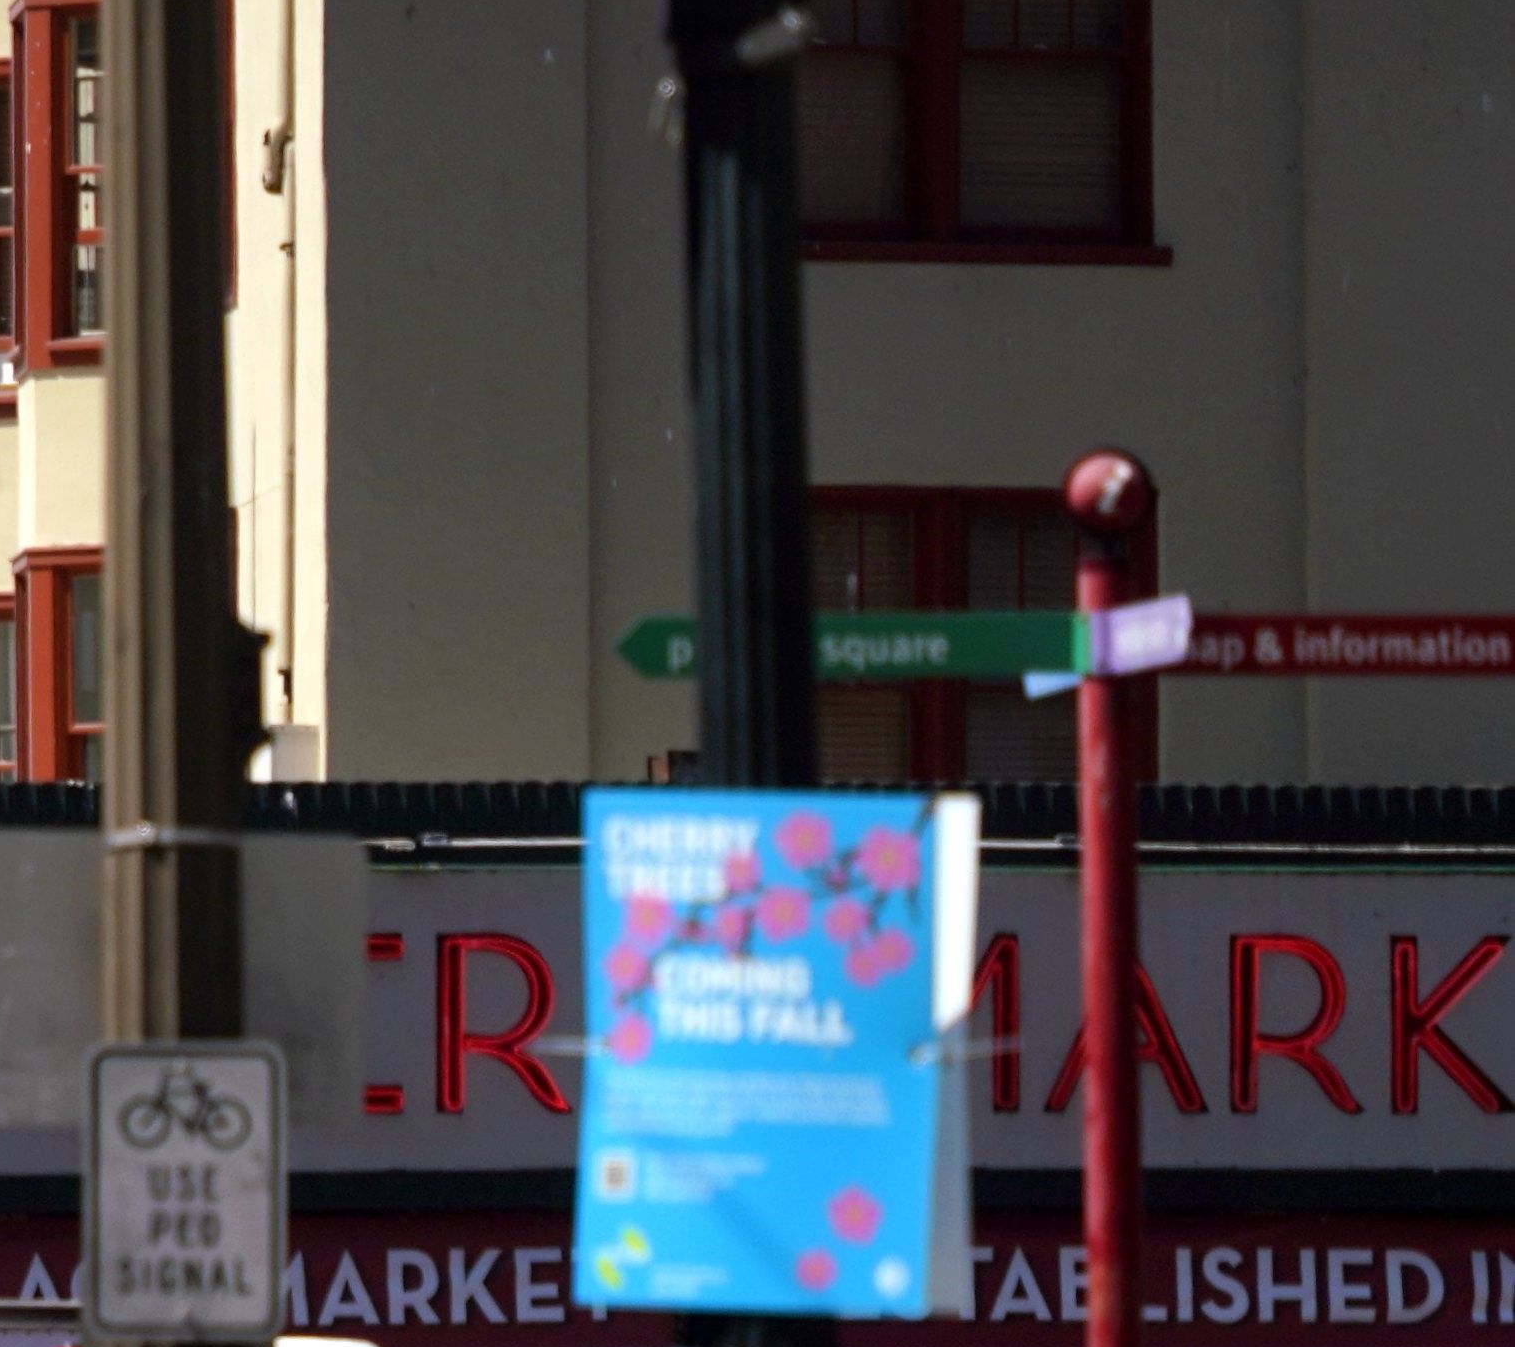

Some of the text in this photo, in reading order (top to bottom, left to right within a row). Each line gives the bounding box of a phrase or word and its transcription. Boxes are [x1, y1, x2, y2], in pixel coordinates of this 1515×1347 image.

[818, 630, 951, 671] square
[1253, 627, 1282, 663] &
[1293, 625, 1511, 664] information
[601, 813, 761, 859] CHERRY
[655, 956, 812, 997] COMING
[656, 997, 741, 1042] THIS
[146, 1164, 218, 1202] USE
[147, 1209, 223, 1249] PED
[116, 1255, 253, 1297] SIGNAL
